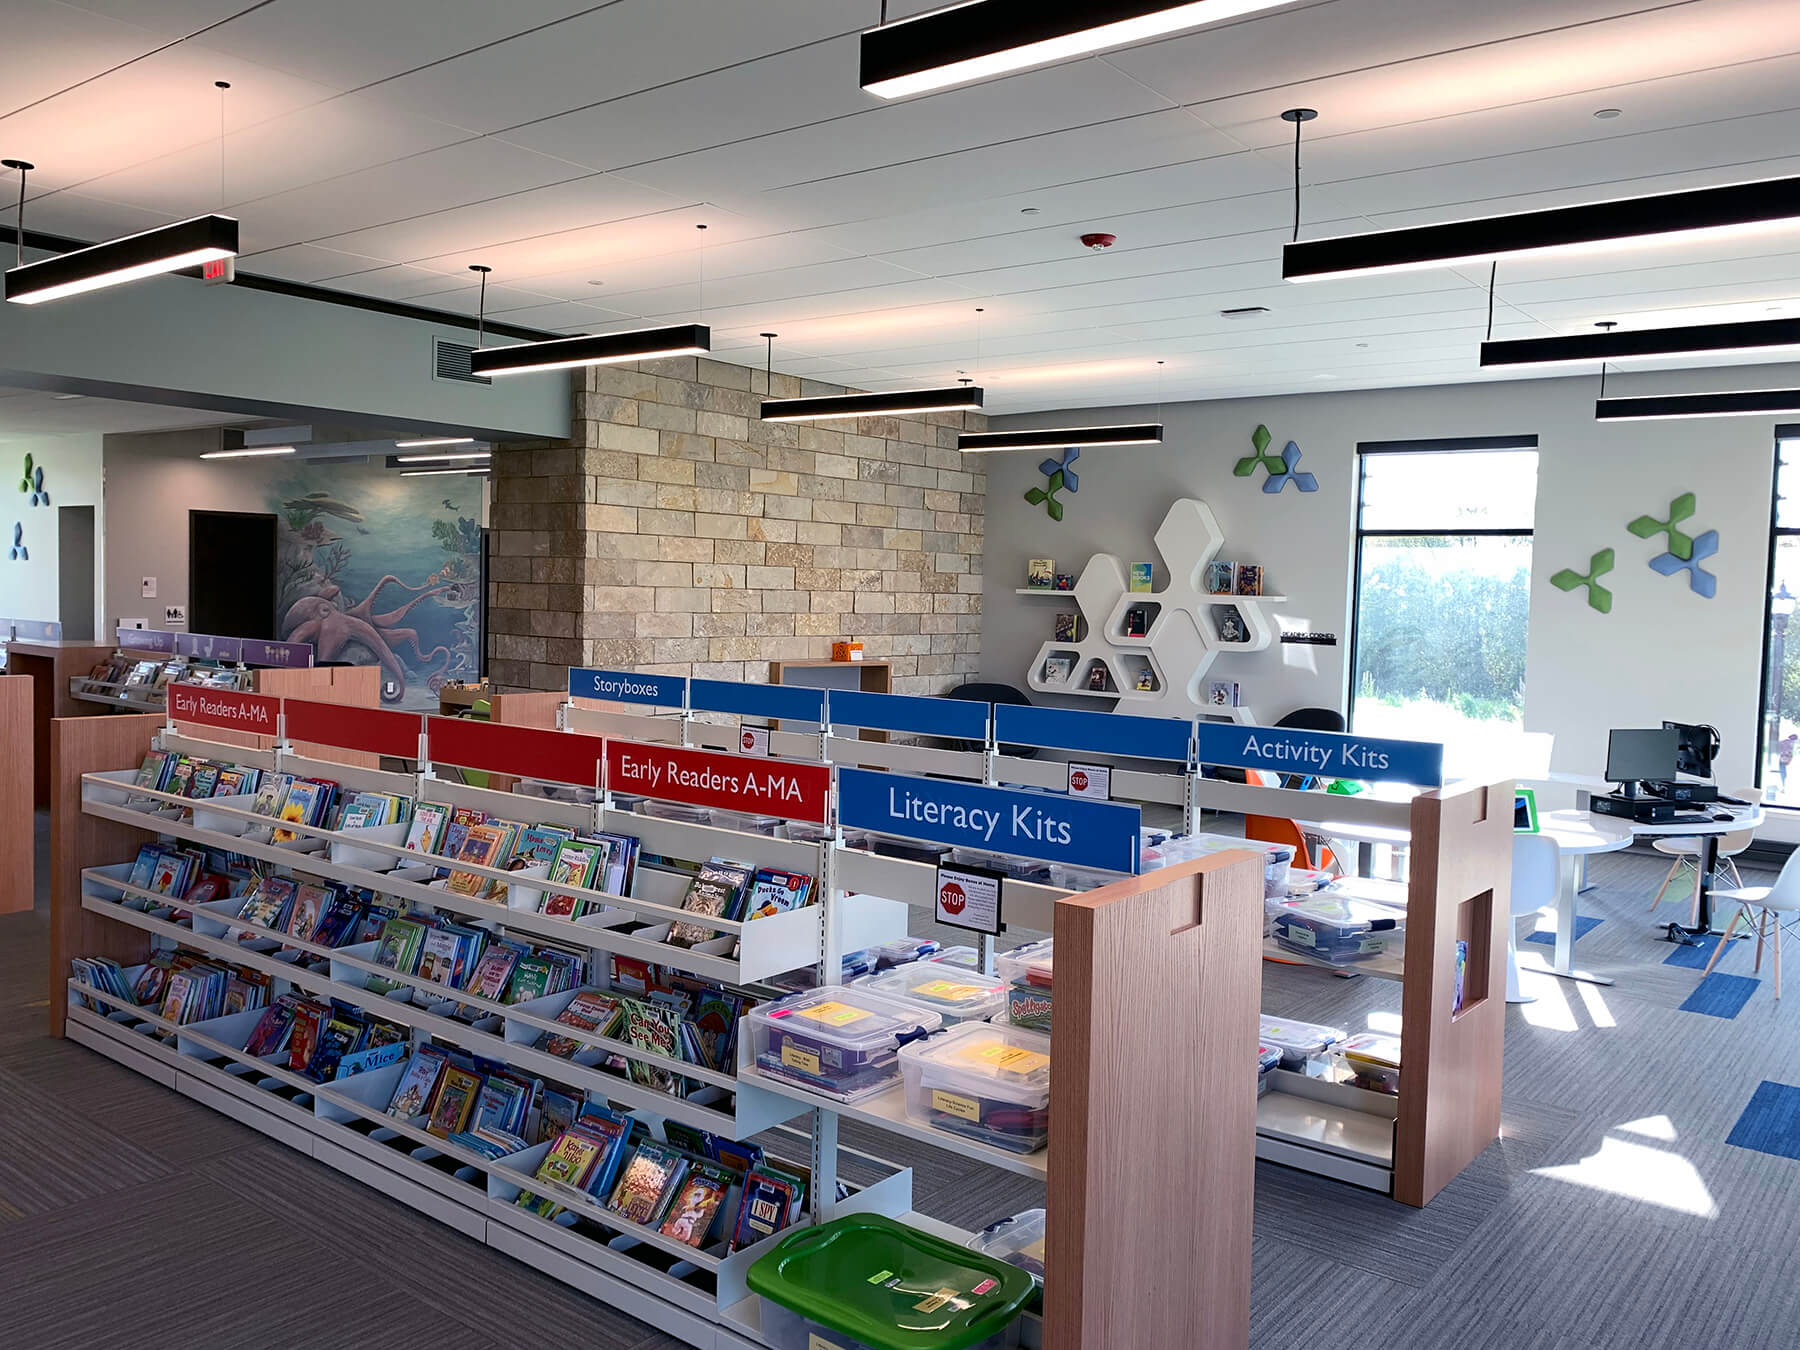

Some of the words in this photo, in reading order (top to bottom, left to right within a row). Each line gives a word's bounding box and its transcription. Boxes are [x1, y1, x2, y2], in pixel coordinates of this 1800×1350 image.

[593, 675, 659, 698] Storyboxes
[175, 693, 198, 717] Early
[199, 697, 237, 719] Readers
[238, 702, 269, 724] A-MA
[1242, 734, 1333, 770] Activity
[1341, 743, 1390, 769] Kits
[621, 754, 662, 788] Early
[667, 761, 739, 793] Readers
[742, 771, 803, 803] A-MA
[1071, 776, 1088, 786] STOP
[889, 786, 1001, 842] Literacy
[1012, 804, 1072, 845] Kits
[941, 890, 965, 906] STOP
[630, 1012, 650, 1028] Can
[651, 1018, 670, 1035] You
[630, 1026, 650, 1041] See
[753, 1199, 759, 1215] I
[759, 1202, 776, 1221] SPY
